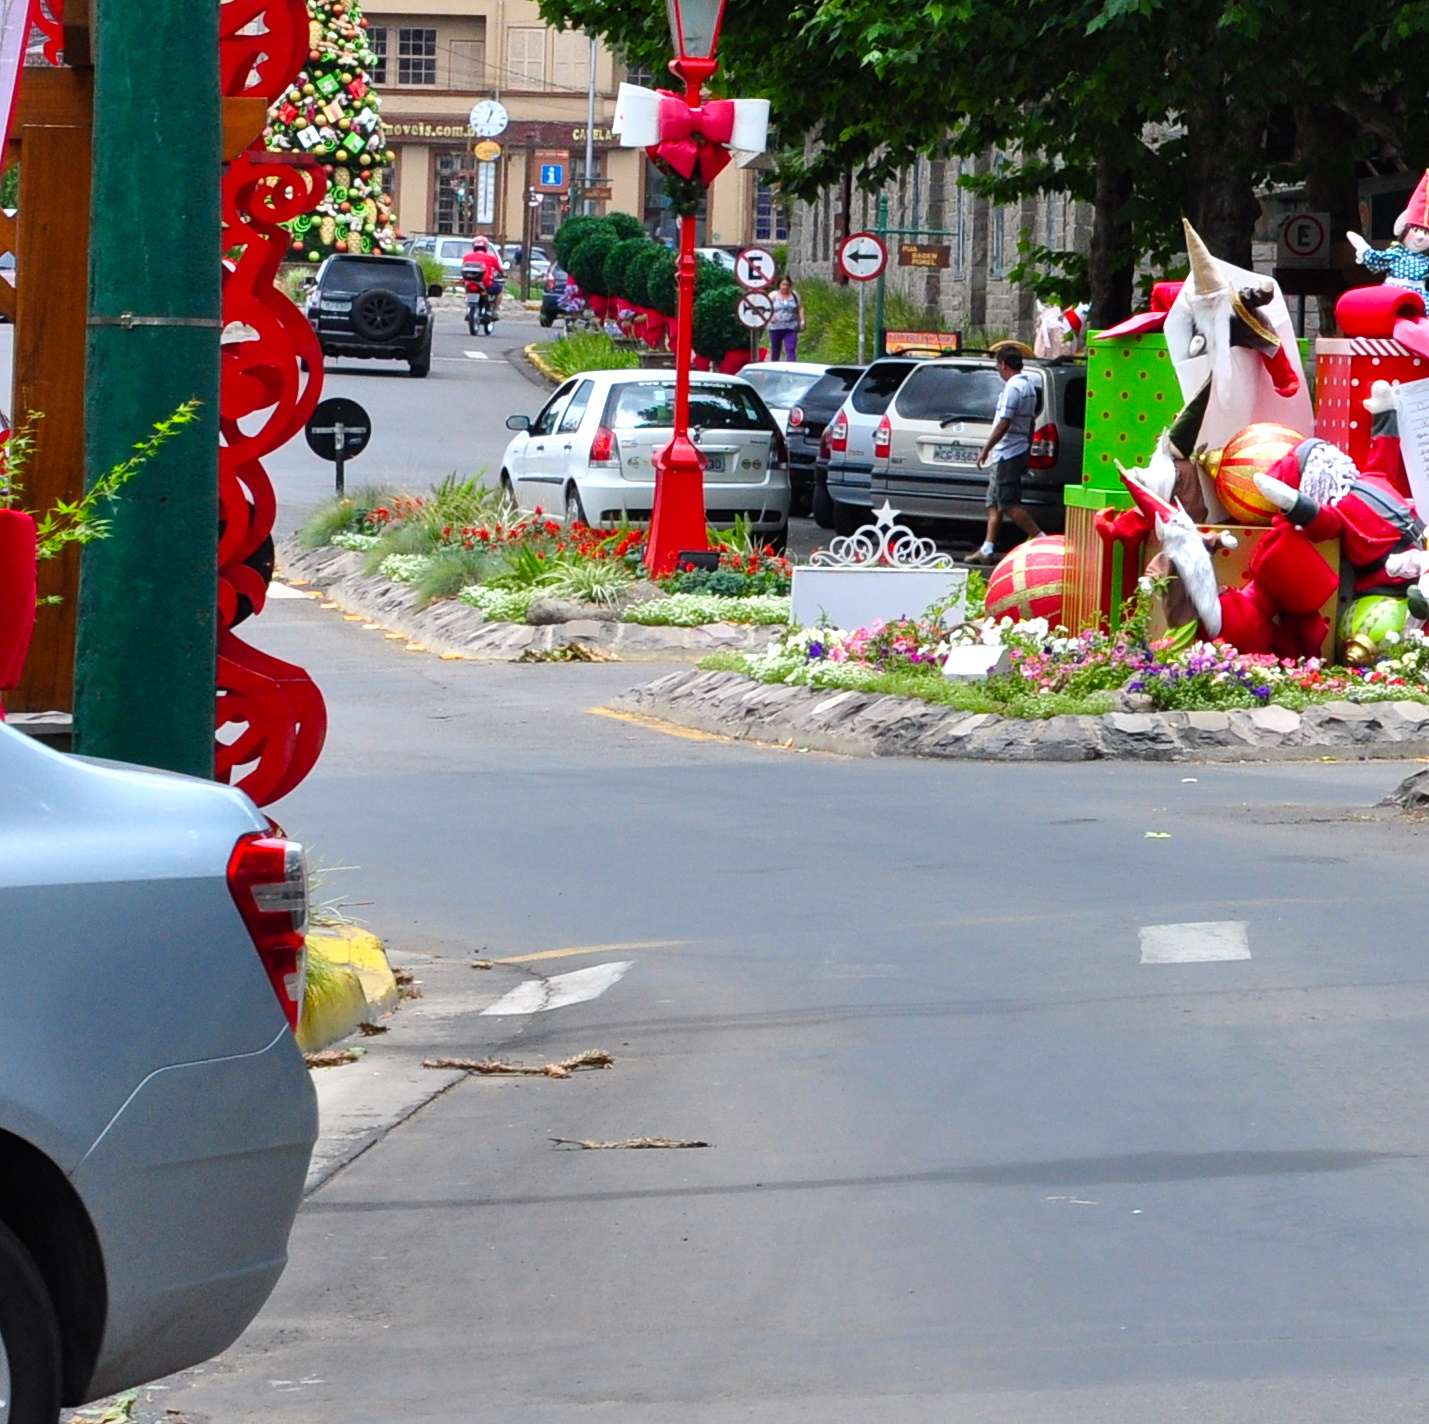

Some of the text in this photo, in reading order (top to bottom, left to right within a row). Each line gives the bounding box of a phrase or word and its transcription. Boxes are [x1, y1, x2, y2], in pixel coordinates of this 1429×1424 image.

[572, 128, 613, 141] CAELA
[1297, 224, 1311, 247] E
[747, 256, 763, 280] E
